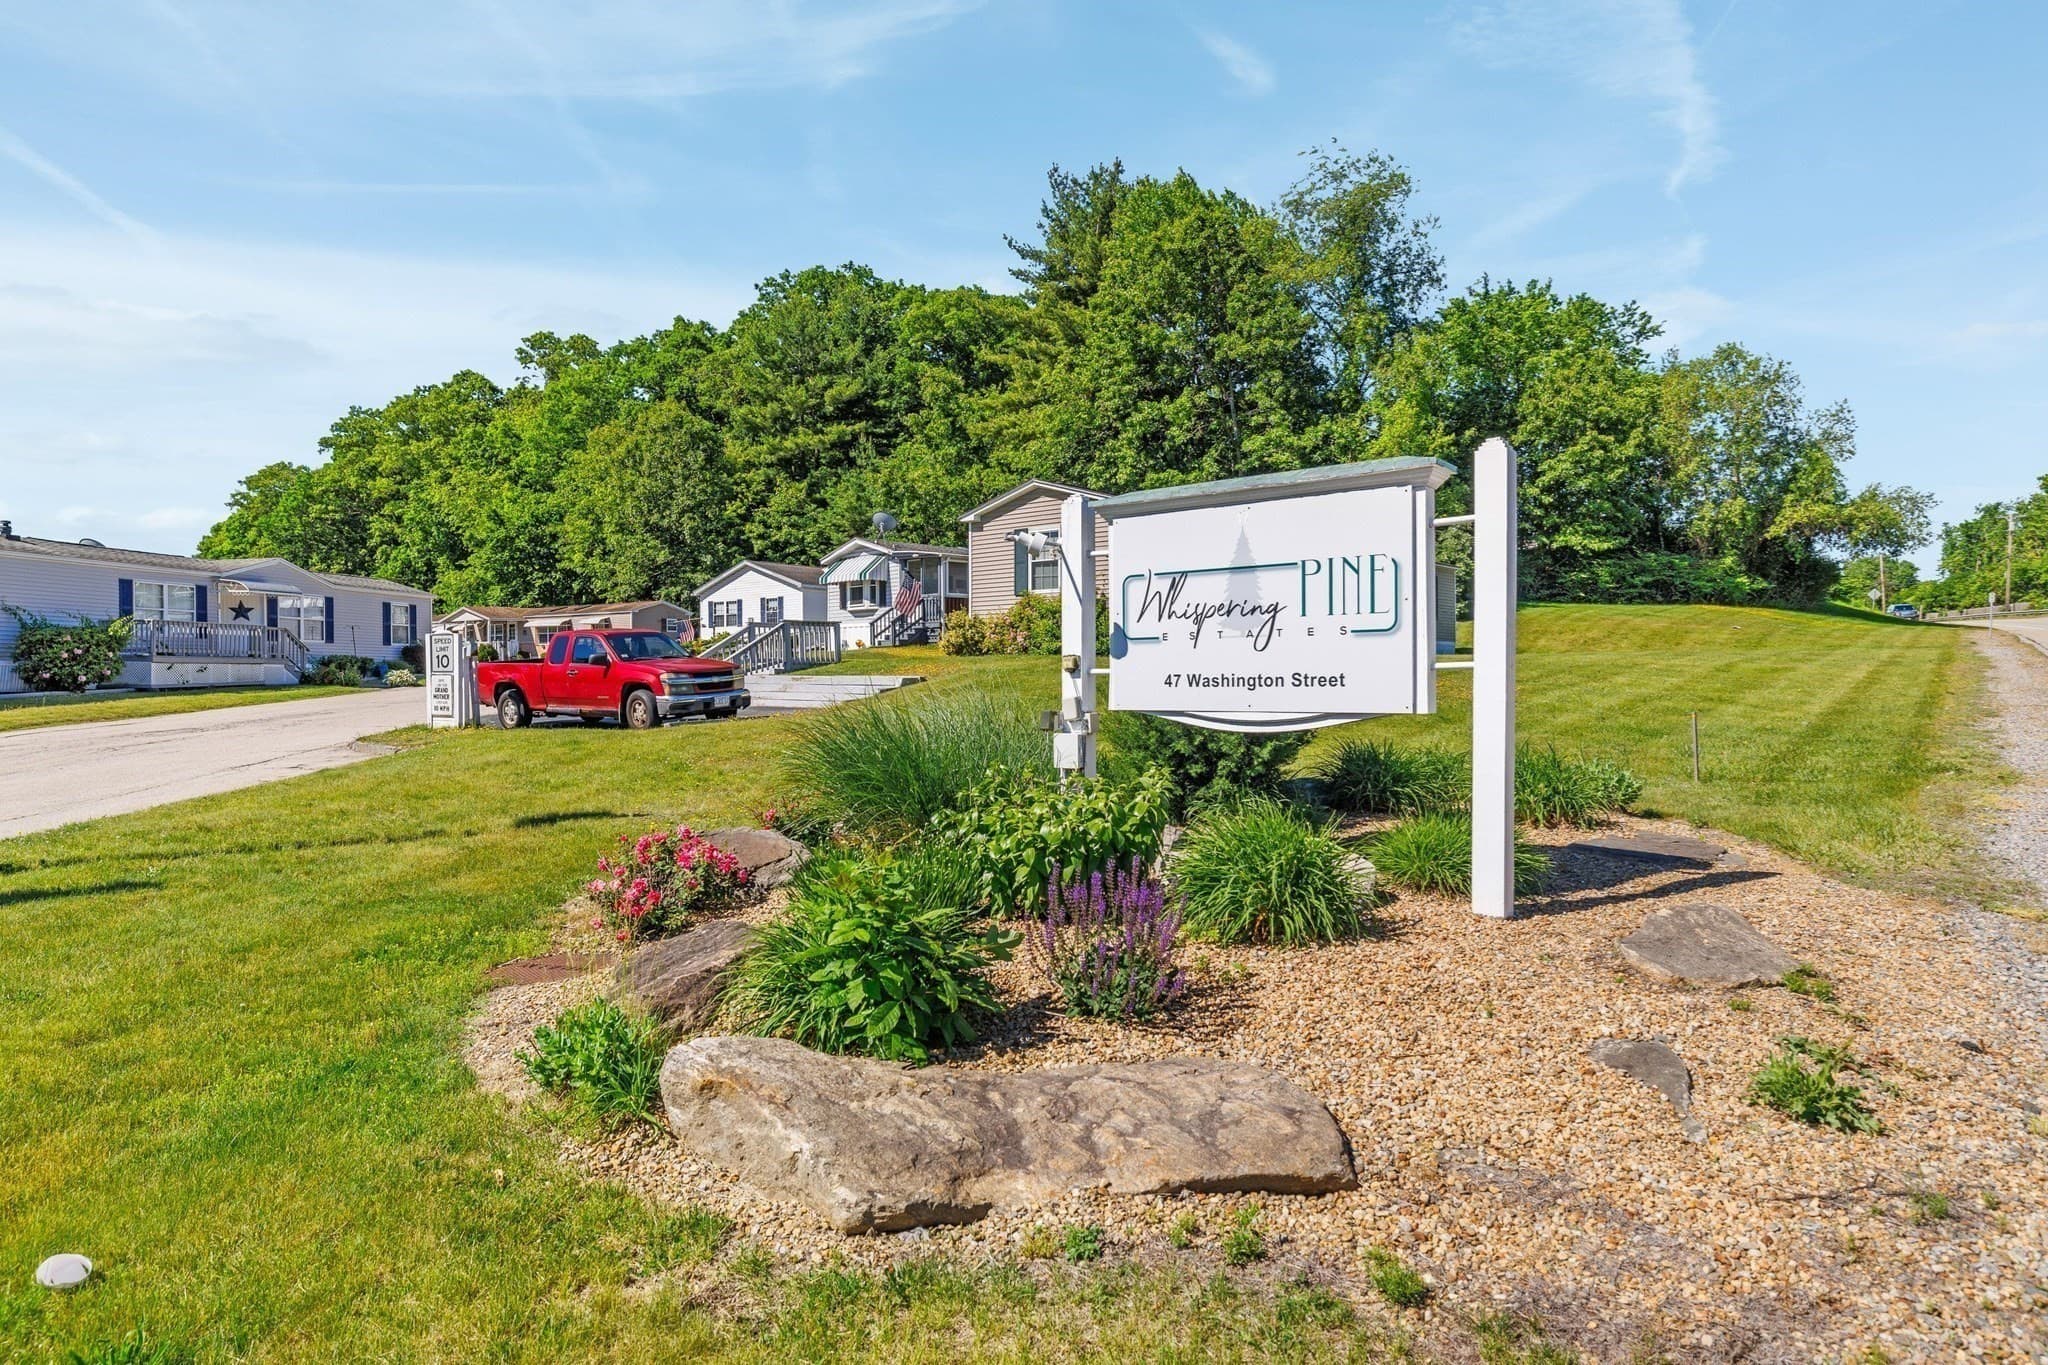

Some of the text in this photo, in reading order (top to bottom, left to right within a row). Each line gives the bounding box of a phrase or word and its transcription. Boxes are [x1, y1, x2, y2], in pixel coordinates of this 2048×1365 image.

[1136, 553, 1391, 652] Whispering PINE
[1161, 626, 1349, 642] ESTATES
[436, 654, 450, 668] 10
[1163, 672, 1346, 692] 47 Washington Street
